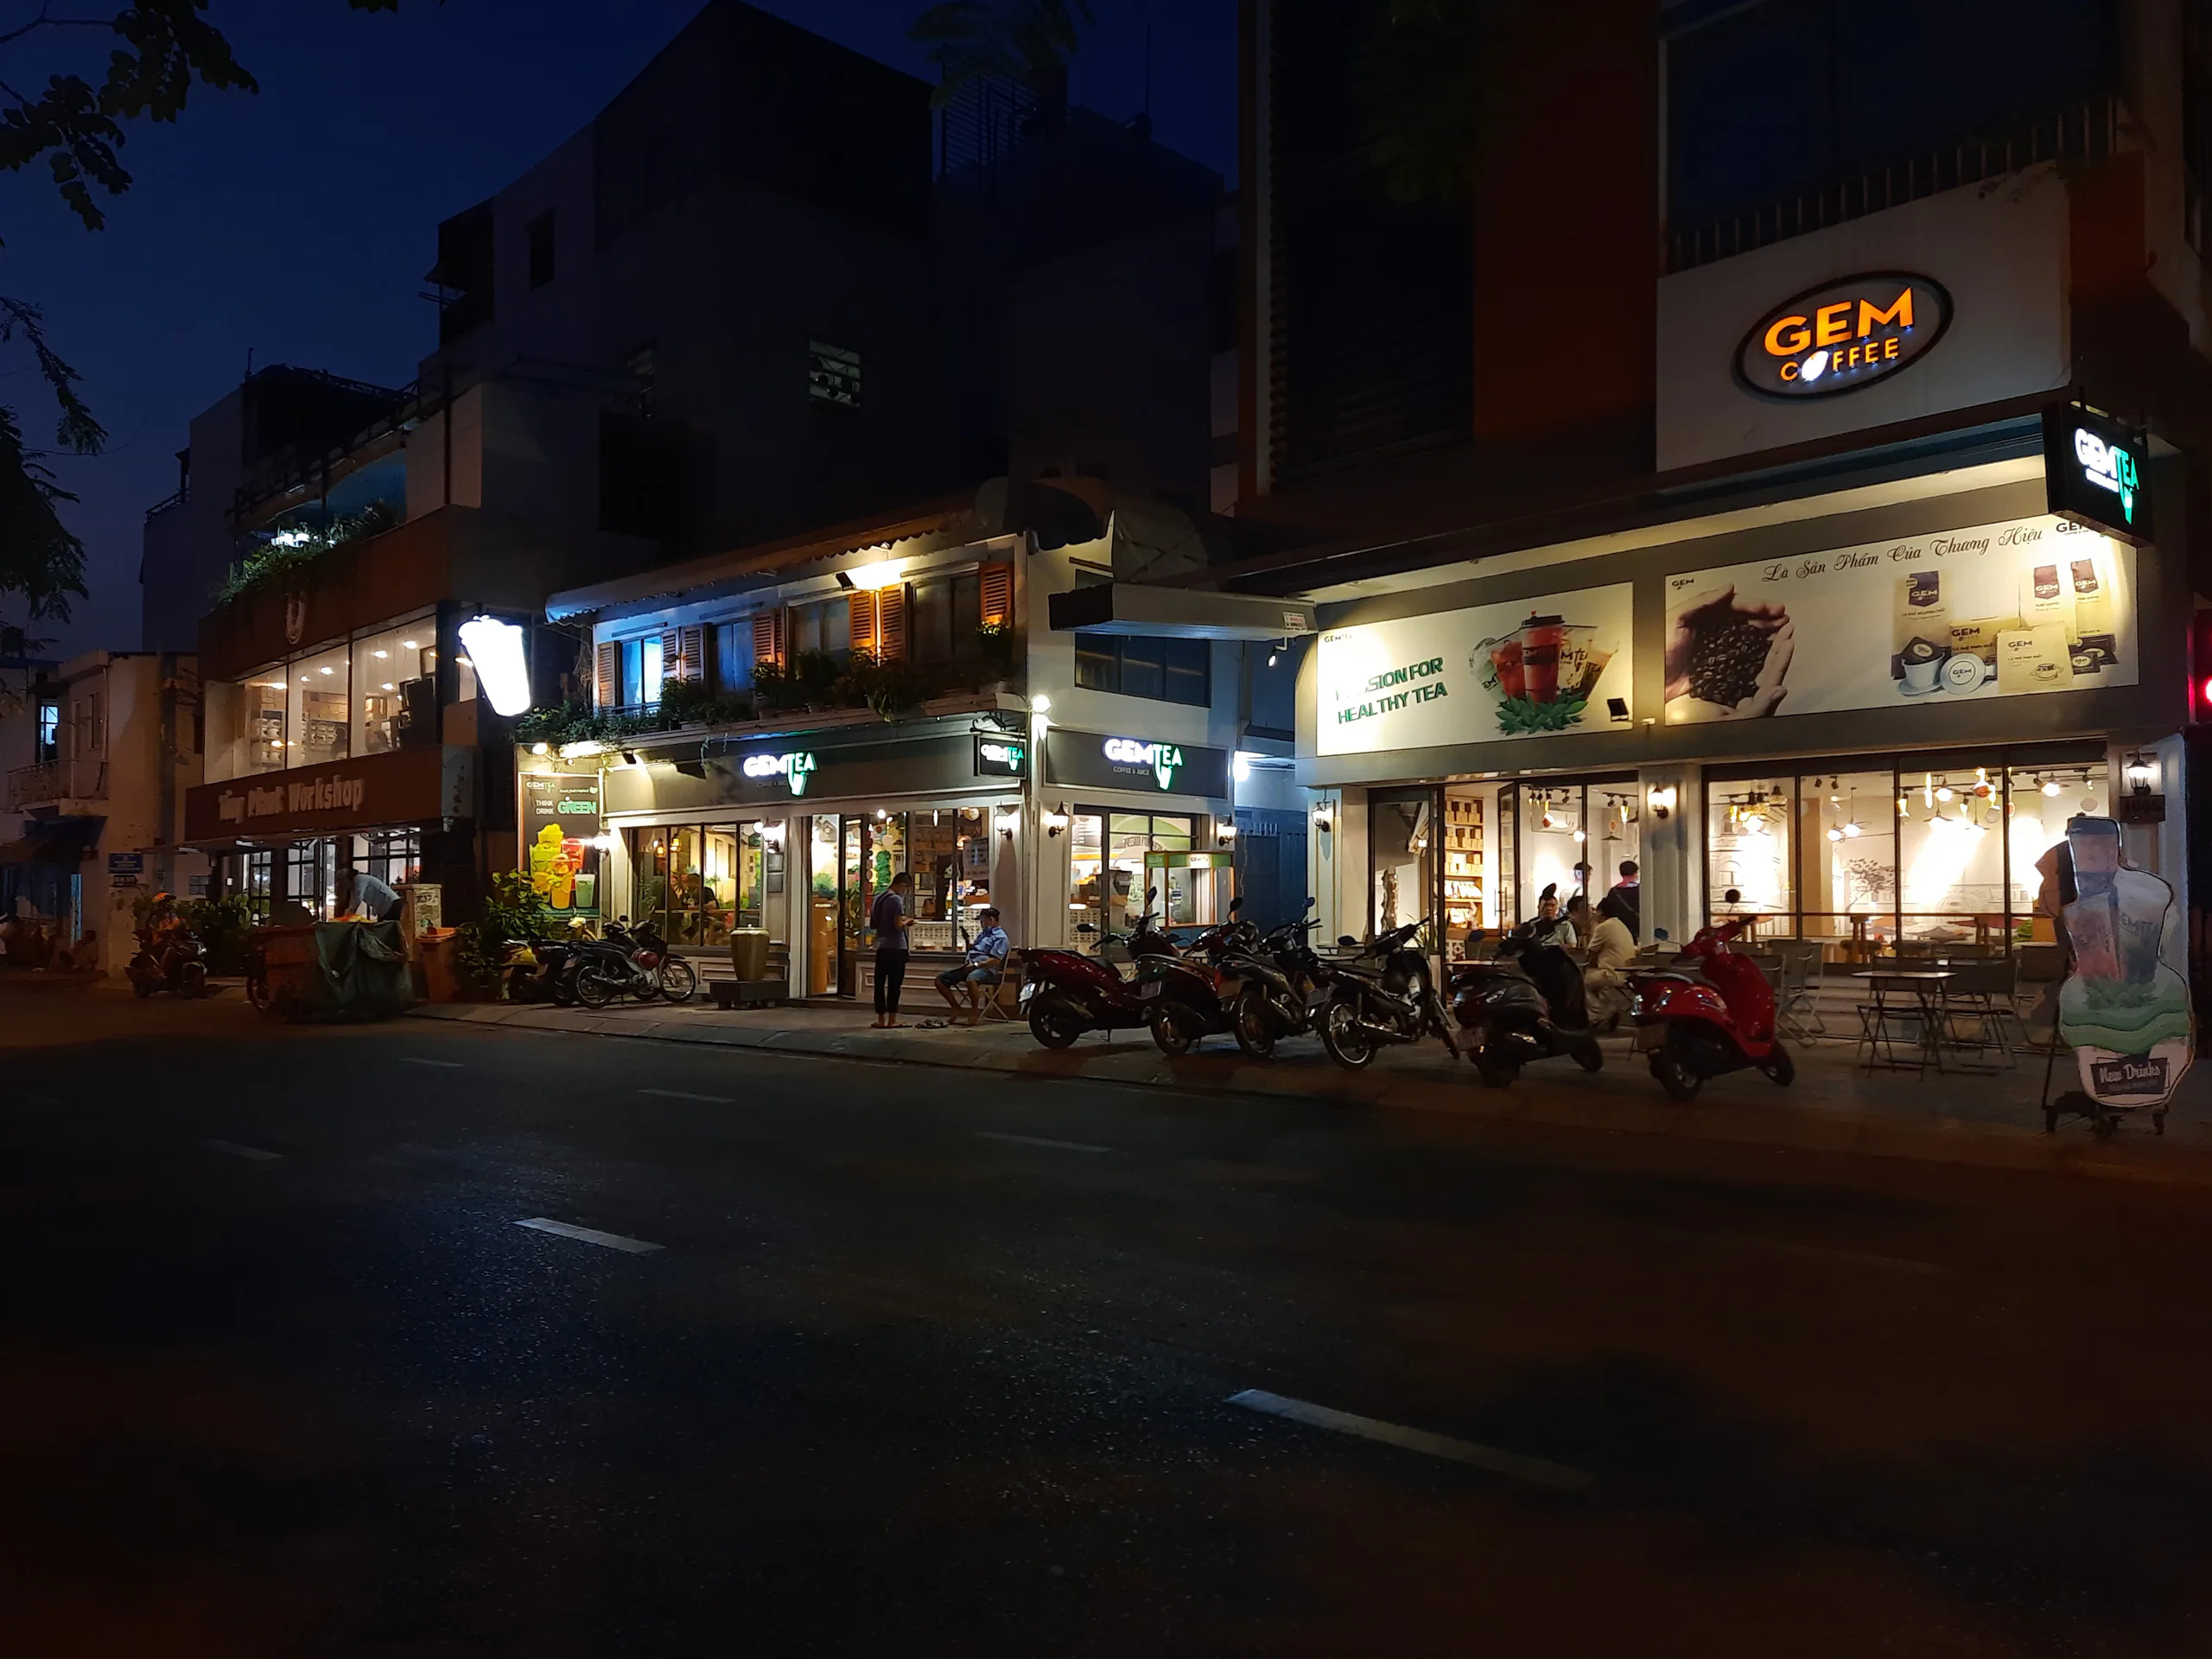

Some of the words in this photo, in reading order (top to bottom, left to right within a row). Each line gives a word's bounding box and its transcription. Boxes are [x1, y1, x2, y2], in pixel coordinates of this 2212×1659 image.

[1764, 286, 1914, 357] GEM
[1779, 337, 1899, 382] COFFEE
[1762, 563, 1789, 582] Là
[1998, 526, 2044, 546] Hiệu
[1952, 627, 1980, 637] GEM
[1409, 657, 1444, 681] FOR
[1338, 690, 1411, 725] HEALTHY
[1412, 681, 1448, 704] TEA
[288, 775, 365, 812] Workshop
[557, 800, 597, 815] GREEN
[2122, 1063, 2161, 1080] Drinks
